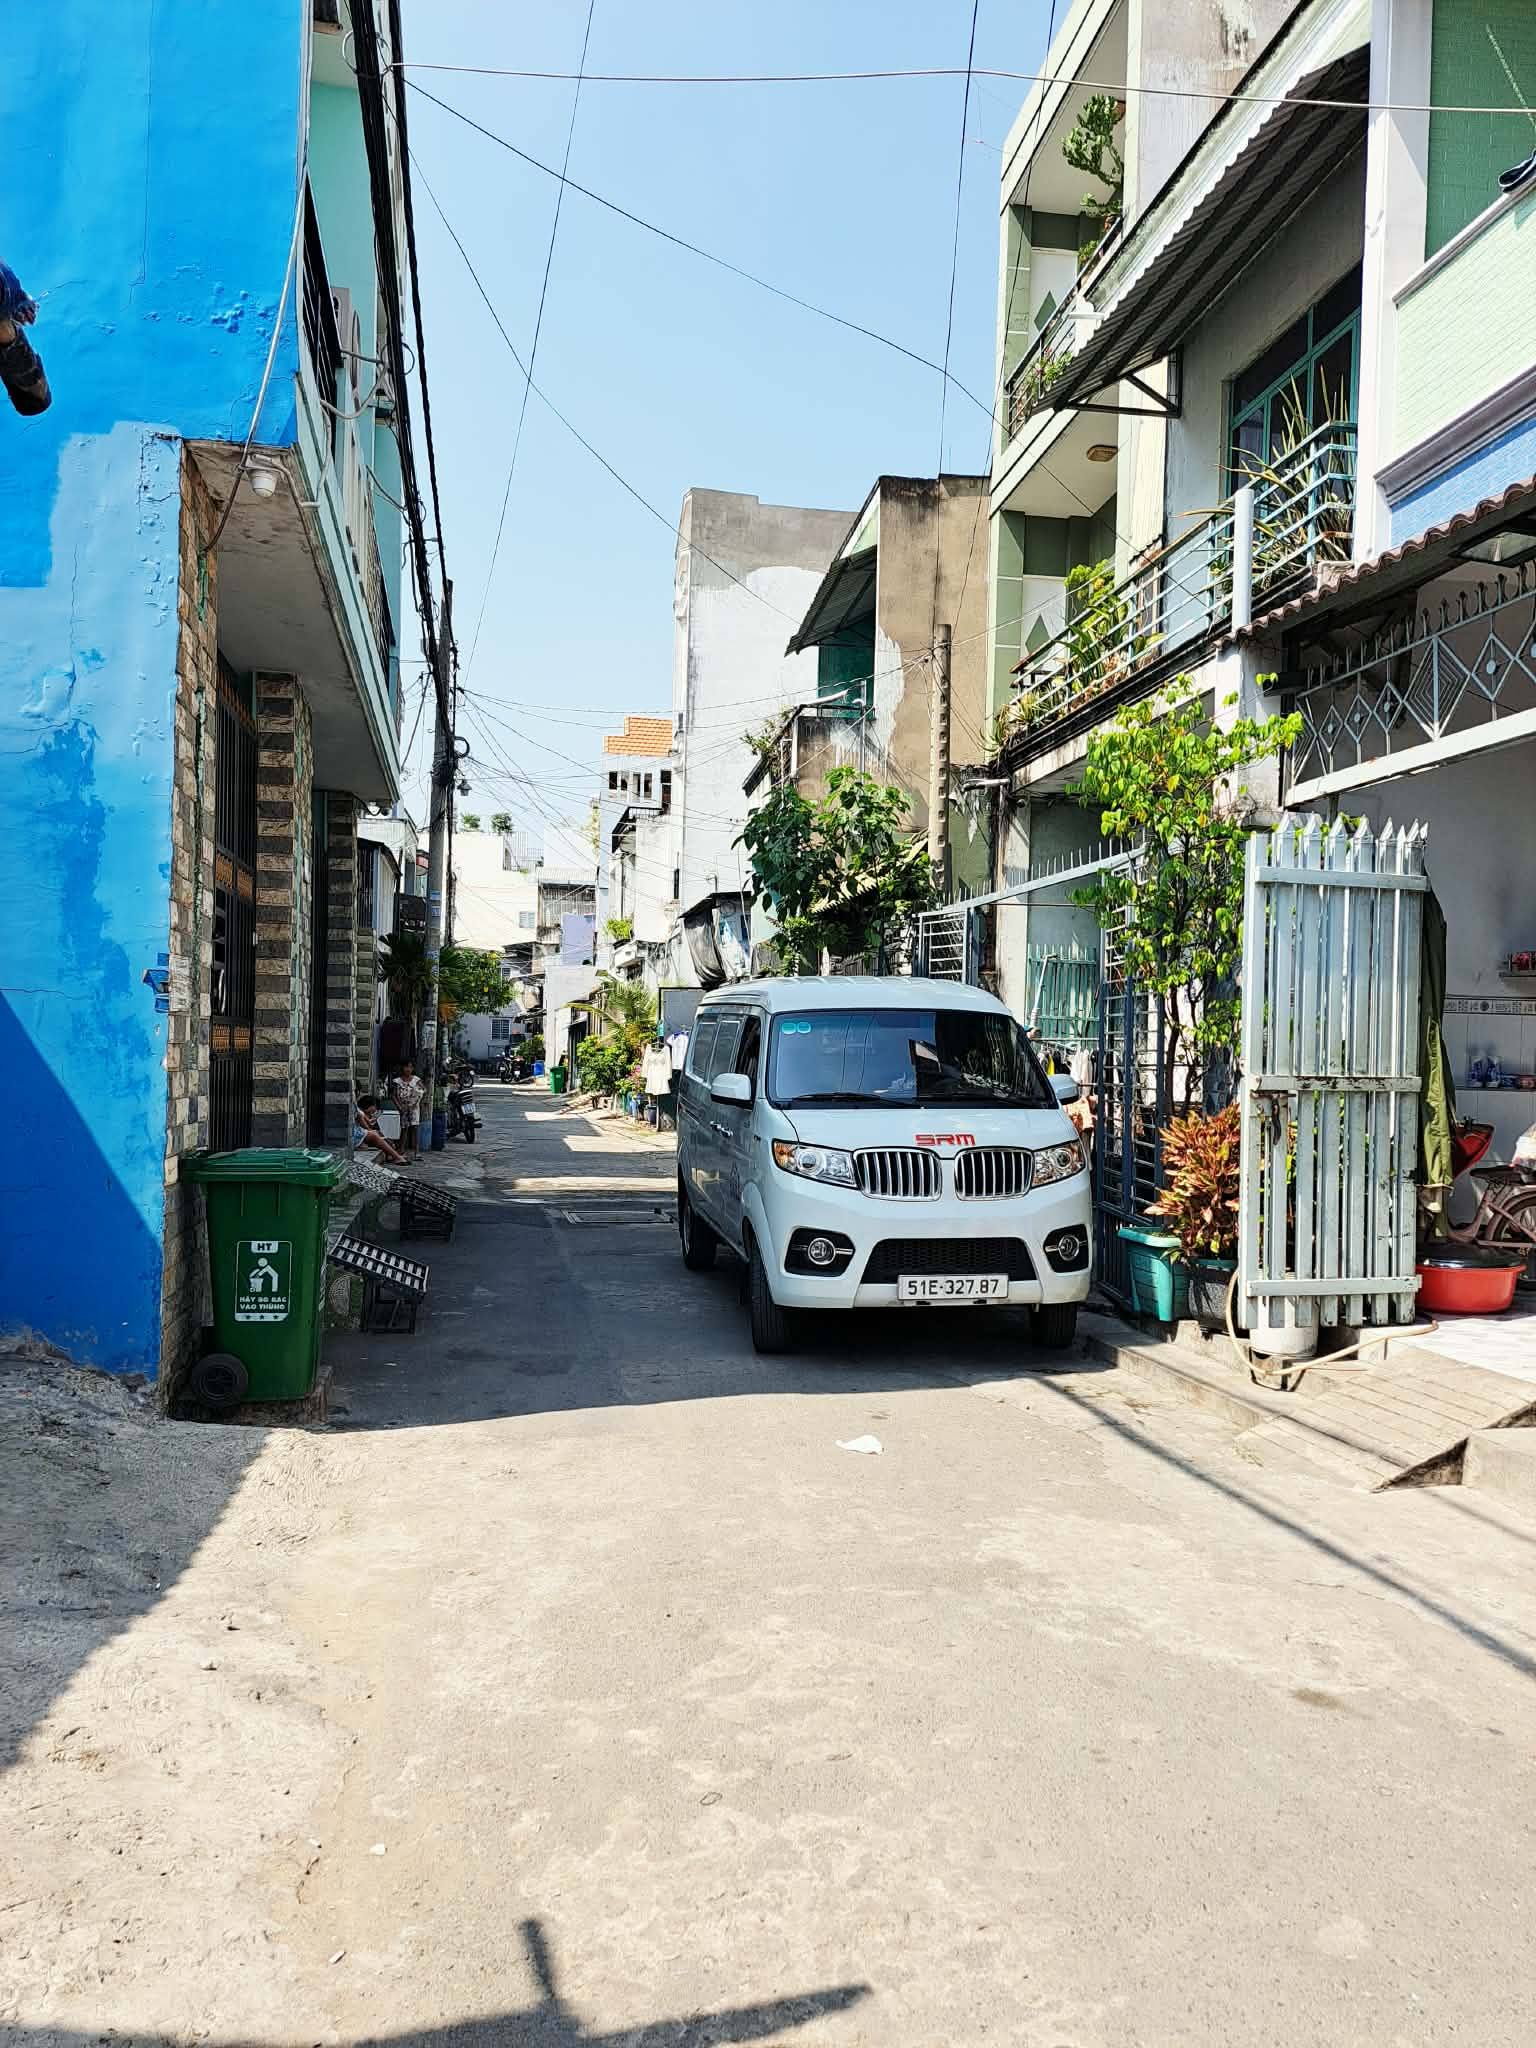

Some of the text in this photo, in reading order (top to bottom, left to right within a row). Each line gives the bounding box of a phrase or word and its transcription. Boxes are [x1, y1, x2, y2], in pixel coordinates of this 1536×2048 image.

[915, 1134, 976, 1147] SRM
[257, 1243, 273, 1251] HT
[908, 1279, 999, 1296] 51E-327.87
